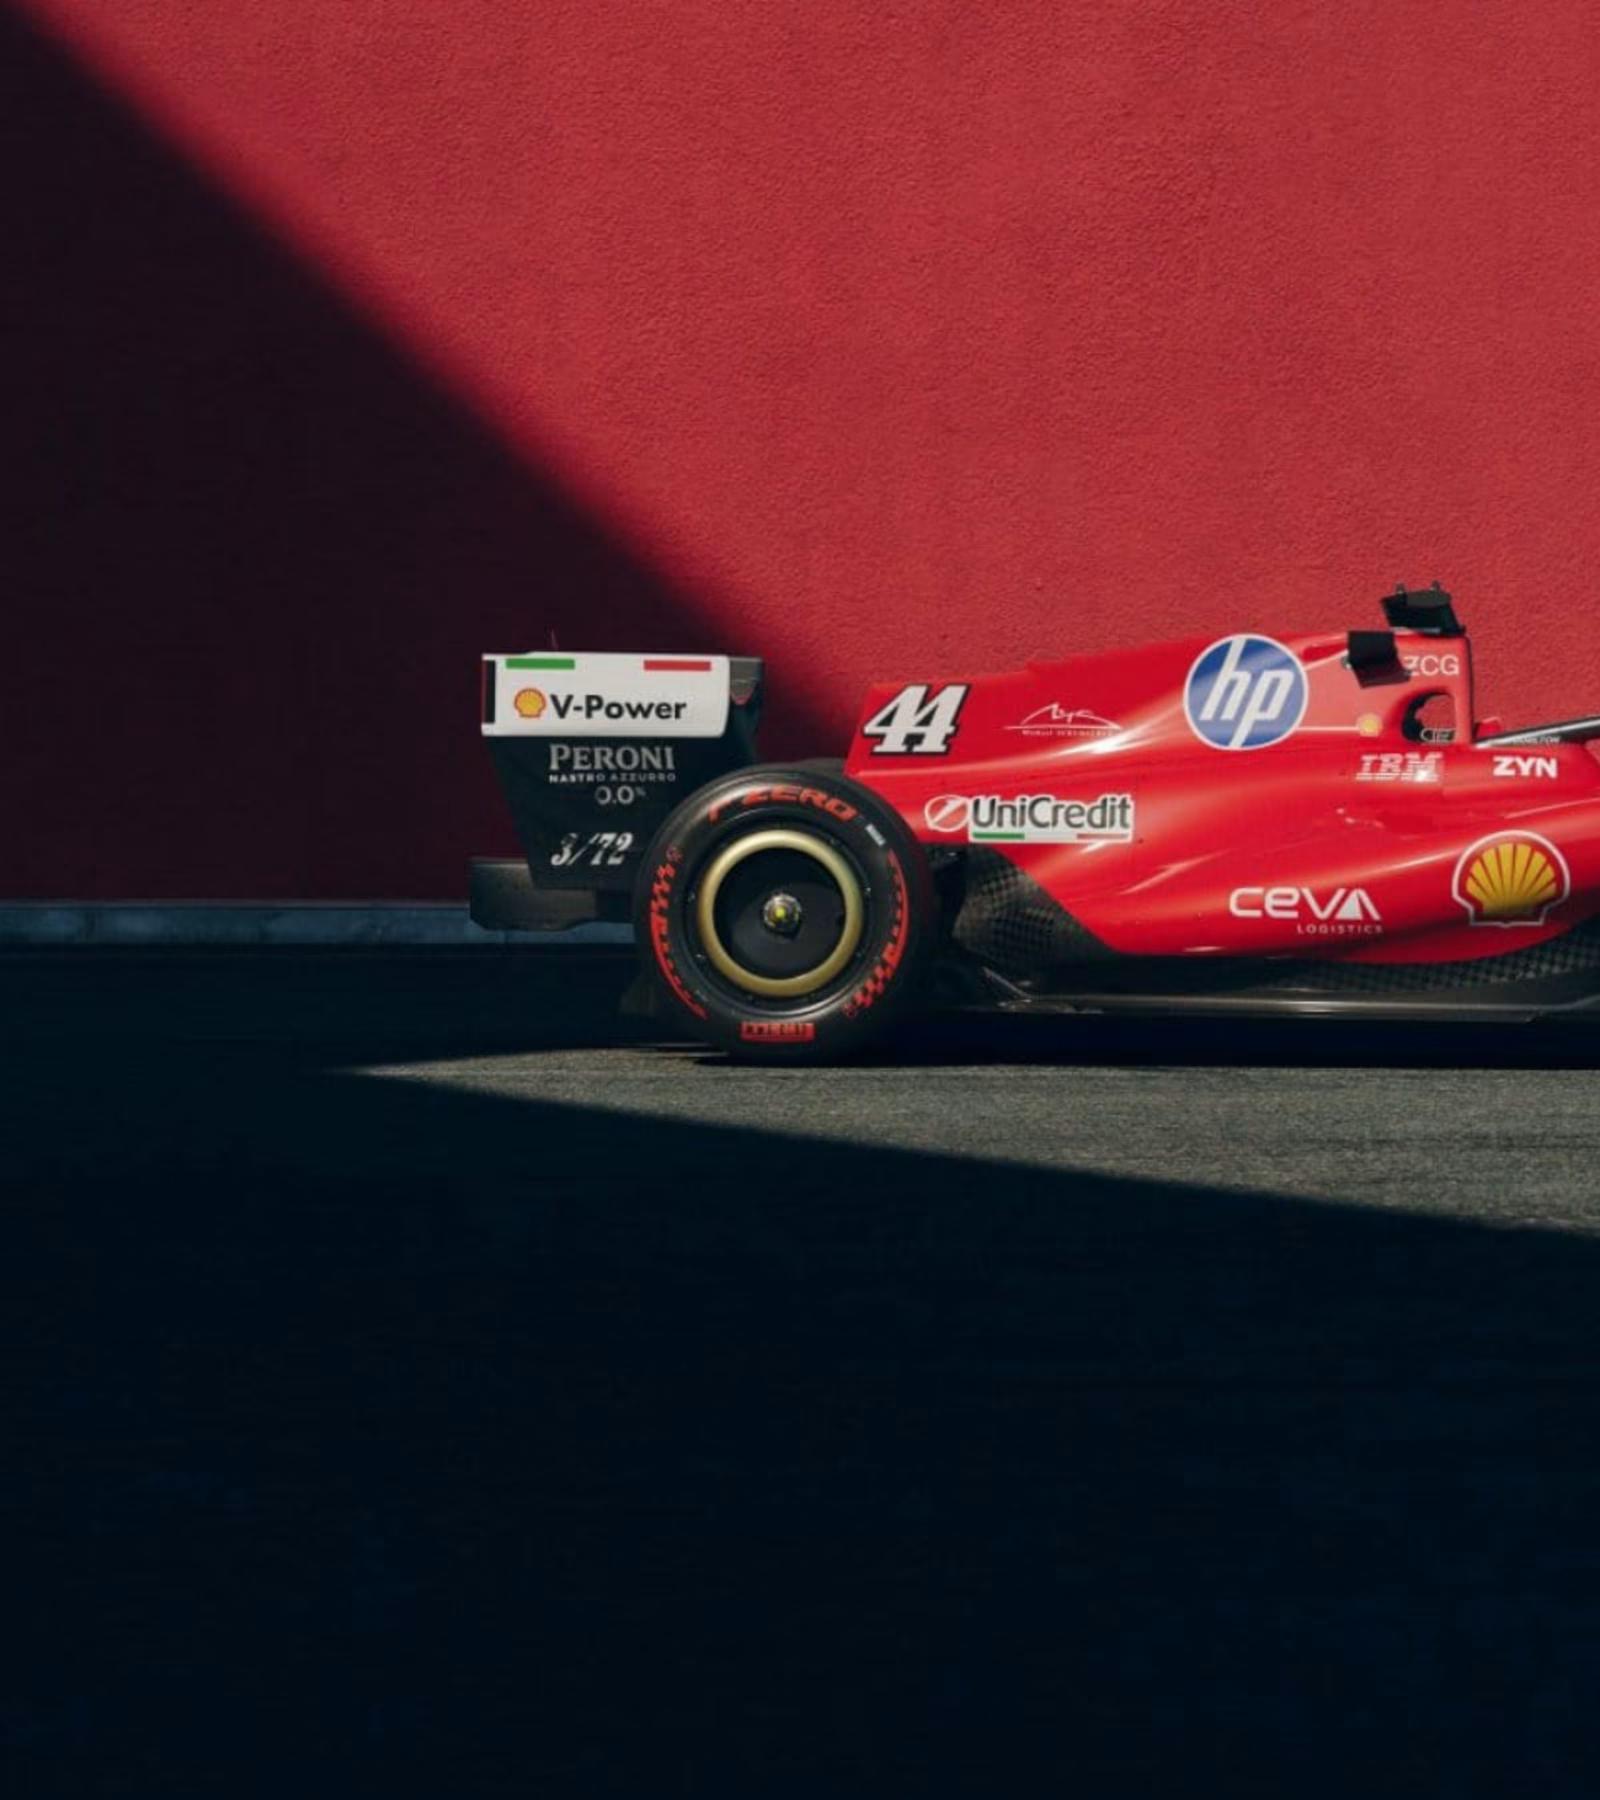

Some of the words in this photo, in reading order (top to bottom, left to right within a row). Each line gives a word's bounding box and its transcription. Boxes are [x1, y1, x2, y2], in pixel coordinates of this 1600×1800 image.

[1200, 637, 1293, 748] hp
[551, 694, 687, 720] V-Power
[864, 684, 970, 753] 44
[549, 744, 676, 771] PERONI
[1356, 752, 1444, 781] IBM
[1493, 755, 1558, 778] ZYN
[972, 797, 1131, 829] UniCredit
[1297, 924, 1383, 934] LOGISTICS
